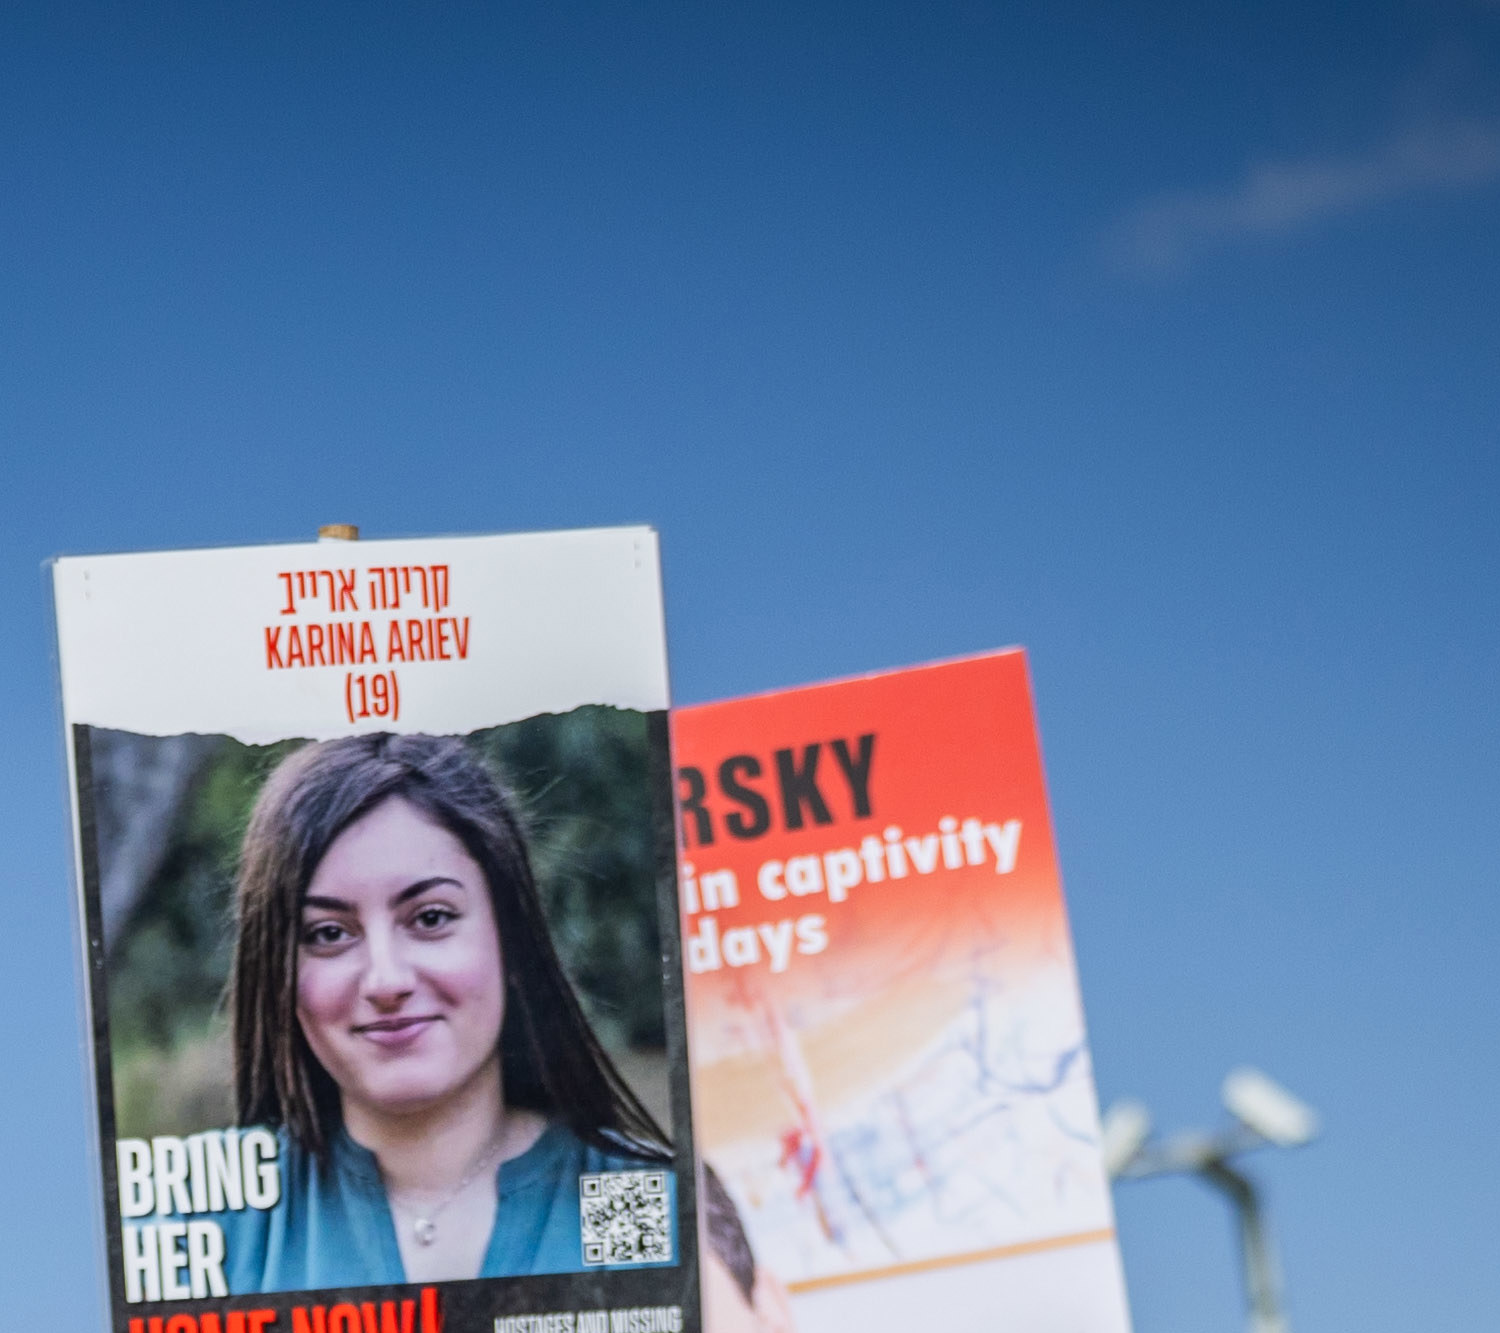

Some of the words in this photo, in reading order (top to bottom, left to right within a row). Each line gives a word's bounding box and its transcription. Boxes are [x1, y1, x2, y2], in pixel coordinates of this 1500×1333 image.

[278, 569, 358, 616] ארייב
[368, 565, 450, 612] קרינה
[265, 621, 377, 670] KARINA
[388, 617, 470, 662] ARIEV
[345, 670, 400, 724] (19)
[683, 866, 739, 914] in
[758, 816, 1023, 903] captivity
[688, 913, 829, 976] days
[117, 1131, 280, 1218] BRING
[124, 1221, 229, 1304] HER
